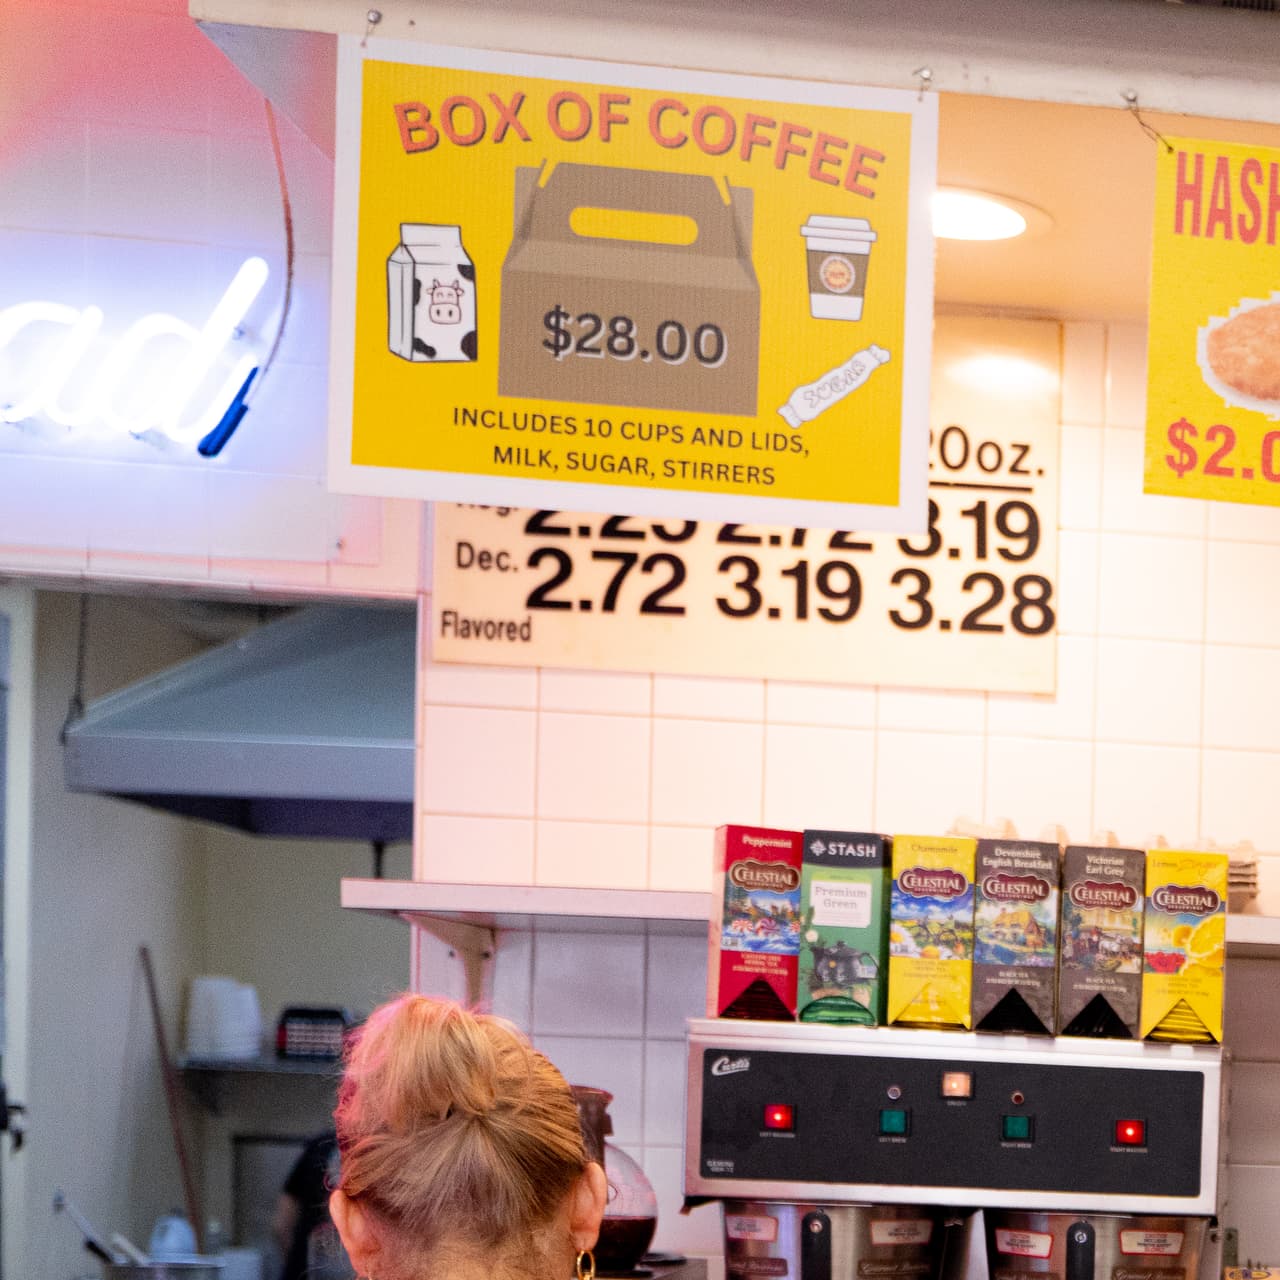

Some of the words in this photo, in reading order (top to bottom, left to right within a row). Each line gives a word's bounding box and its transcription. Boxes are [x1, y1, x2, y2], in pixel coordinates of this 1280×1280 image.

[394, 92, 531, 154] BOX
[548, 91, 630, 142] OF
[648, 98, 885, 199] COFFEE
[542, 304, 728, 368] $28.00
[453, 407, 577, 435] INCLUDES
[585, 418, 613, 438] 10
[620, 421, 685, 445] CUPS
[691, 427, 743, 449] AND
[752, 432, 811, 459] LIDS,
[929, 426, 1045, 477] 0oz.
[494, 446, 560, 473] MILK,
[566, 455, 656, 480] SUGAR,
[663, 459, 776, 486] STIRRERS
[456, 542, 518, 572] Dec.
[525, 547, 686, 616] 2.72
[716, 555, 863, 623] 3.19
[889, 568, 1055, 637] 3.28
[441, 610, 531, 642] Flavored
[742, 835, 792, 849] Peppermint
[828, 844, 876, 857] STASH
[994, 848, 1041, 859] Devonshire
[1087, 855, 1124, 866] Victorian
[983, 857, 1012, 869] English
[1014, 859, 1053, 870] Breakfast
[1086, 865, 1101, 875] Earl
[1102, 866, 1125, 877] Grey
[734, 866, 794, 887] CELESTIAL
[902, 875, 962, 891] CELESTIAL
[815, 886, 867, 897] Premium
[985, 878, 1046, 898] CELESTIAL
[1074, 885, 1134, 905] CELESTIAL
[823, 898, 858, 909] Green
[1155, 890, 1215, 909] CELESTIAL
